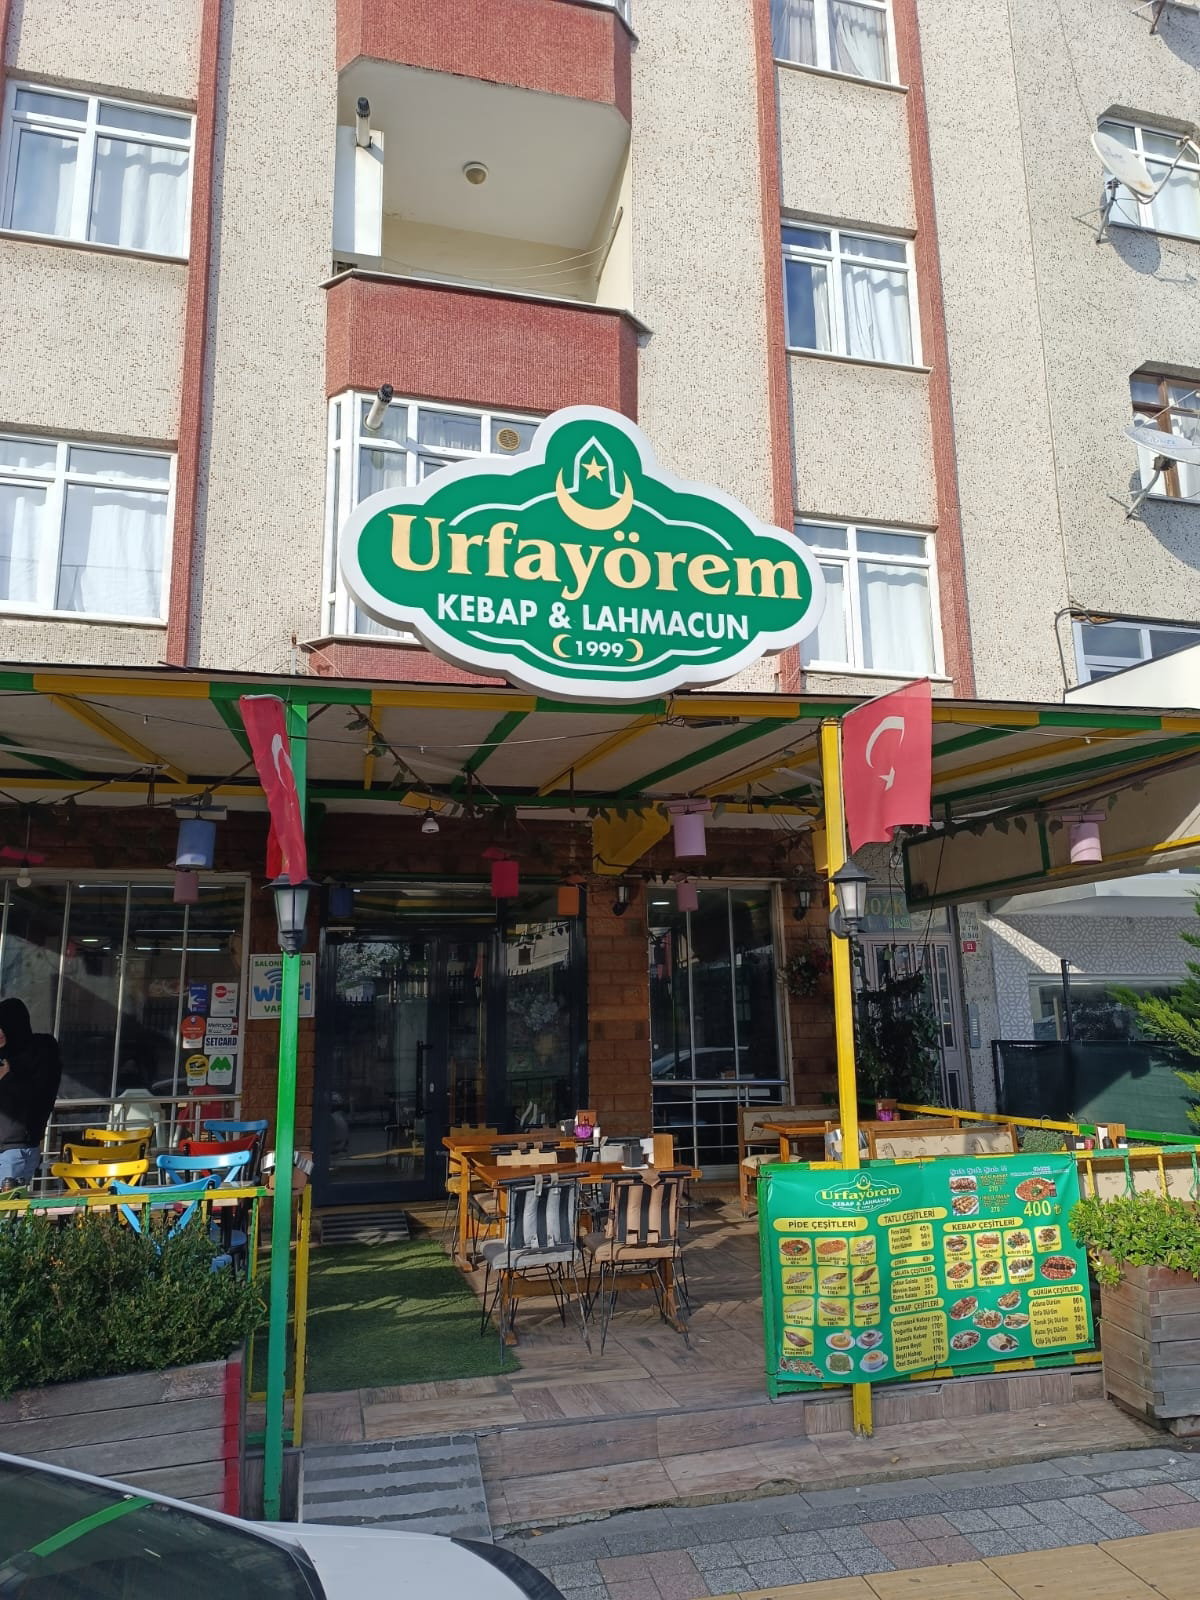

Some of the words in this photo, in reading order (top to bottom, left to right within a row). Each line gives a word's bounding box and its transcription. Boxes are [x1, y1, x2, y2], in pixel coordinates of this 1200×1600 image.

[388, 513, 802, 600] Urfayörem
[437, 593, 538, 626] KEBAP
[548, 604, 571, 629] &
[582, 604, 749, 640] LAHMACUN
[575, 639, 625, 658] 1999
[206, 1037, 238, 1046] SETCARD
[821, 1186, 900, 1201] Urfayörem
[1023, 1200, 1052, 1216] 400
[884, 1215, 900, 1224] TATLI
[902, 1210, 935, 1222] ÇEŞİTLERİ
[788, 1220, 809, 1228] PİDE
[811, 1219, 857, 1230] ÇEŞİTLERİ
[952, 1223, 977, 1231] KEBAP
[979, 1218, 1015, 1229] ÇEŞİTLERİ
[1033, 1287, 1052, 1295] DÜRÜM
